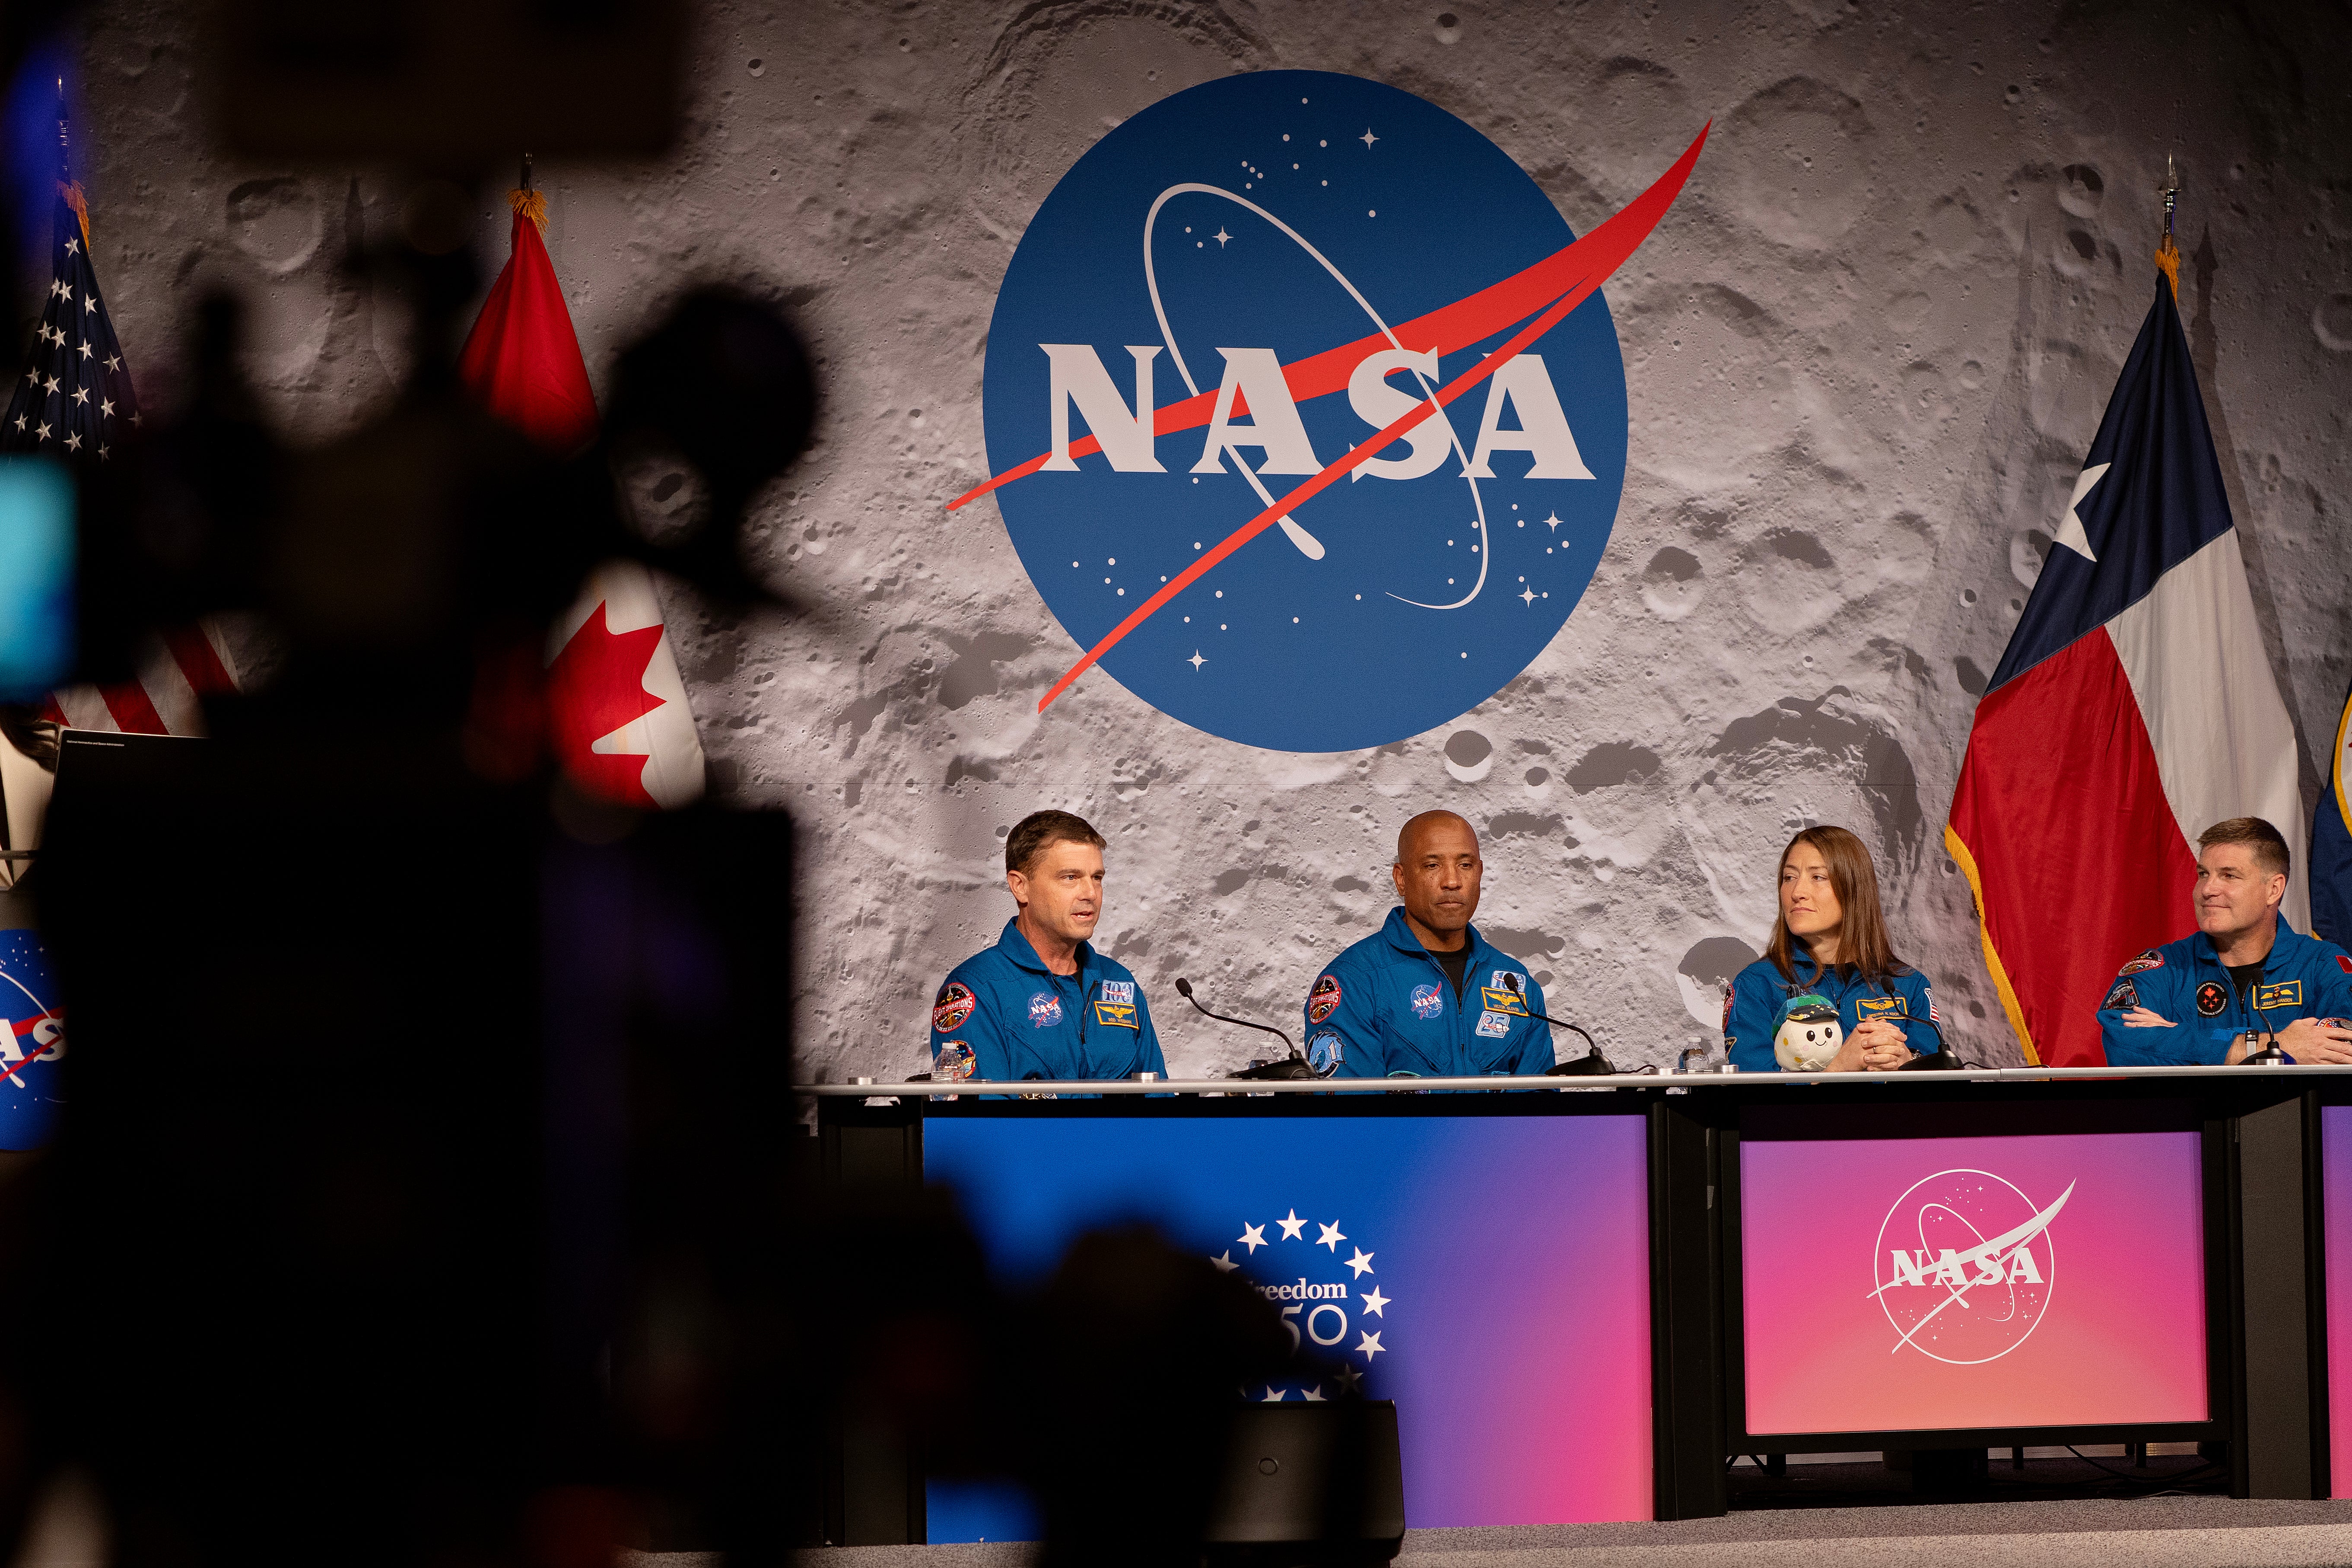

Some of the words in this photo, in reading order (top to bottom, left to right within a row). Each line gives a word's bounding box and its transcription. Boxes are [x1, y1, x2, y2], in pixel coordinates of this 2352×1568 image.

[1038, 343, 1597, 483] NASA
[1494, 972, 1524, 990] 10
[2196, 984, 2206, 996] ANADIAN
[1105, 982, 1132, 1002] 100
[946, 996, 973, 1011] OPERATIONS
[1030, 1003, 1061, 1015] NASA
[1413, 996, 1441, 1008] NASA
[1481, 1015, 1505, 1034] 25
[0, 1018, 68, 1063] AS
[1890, 1247, 2044, 1286] NASA
[1253, 1277, 1348, 1300] reedom
[1280, 1302, 1348, 1358] 50
